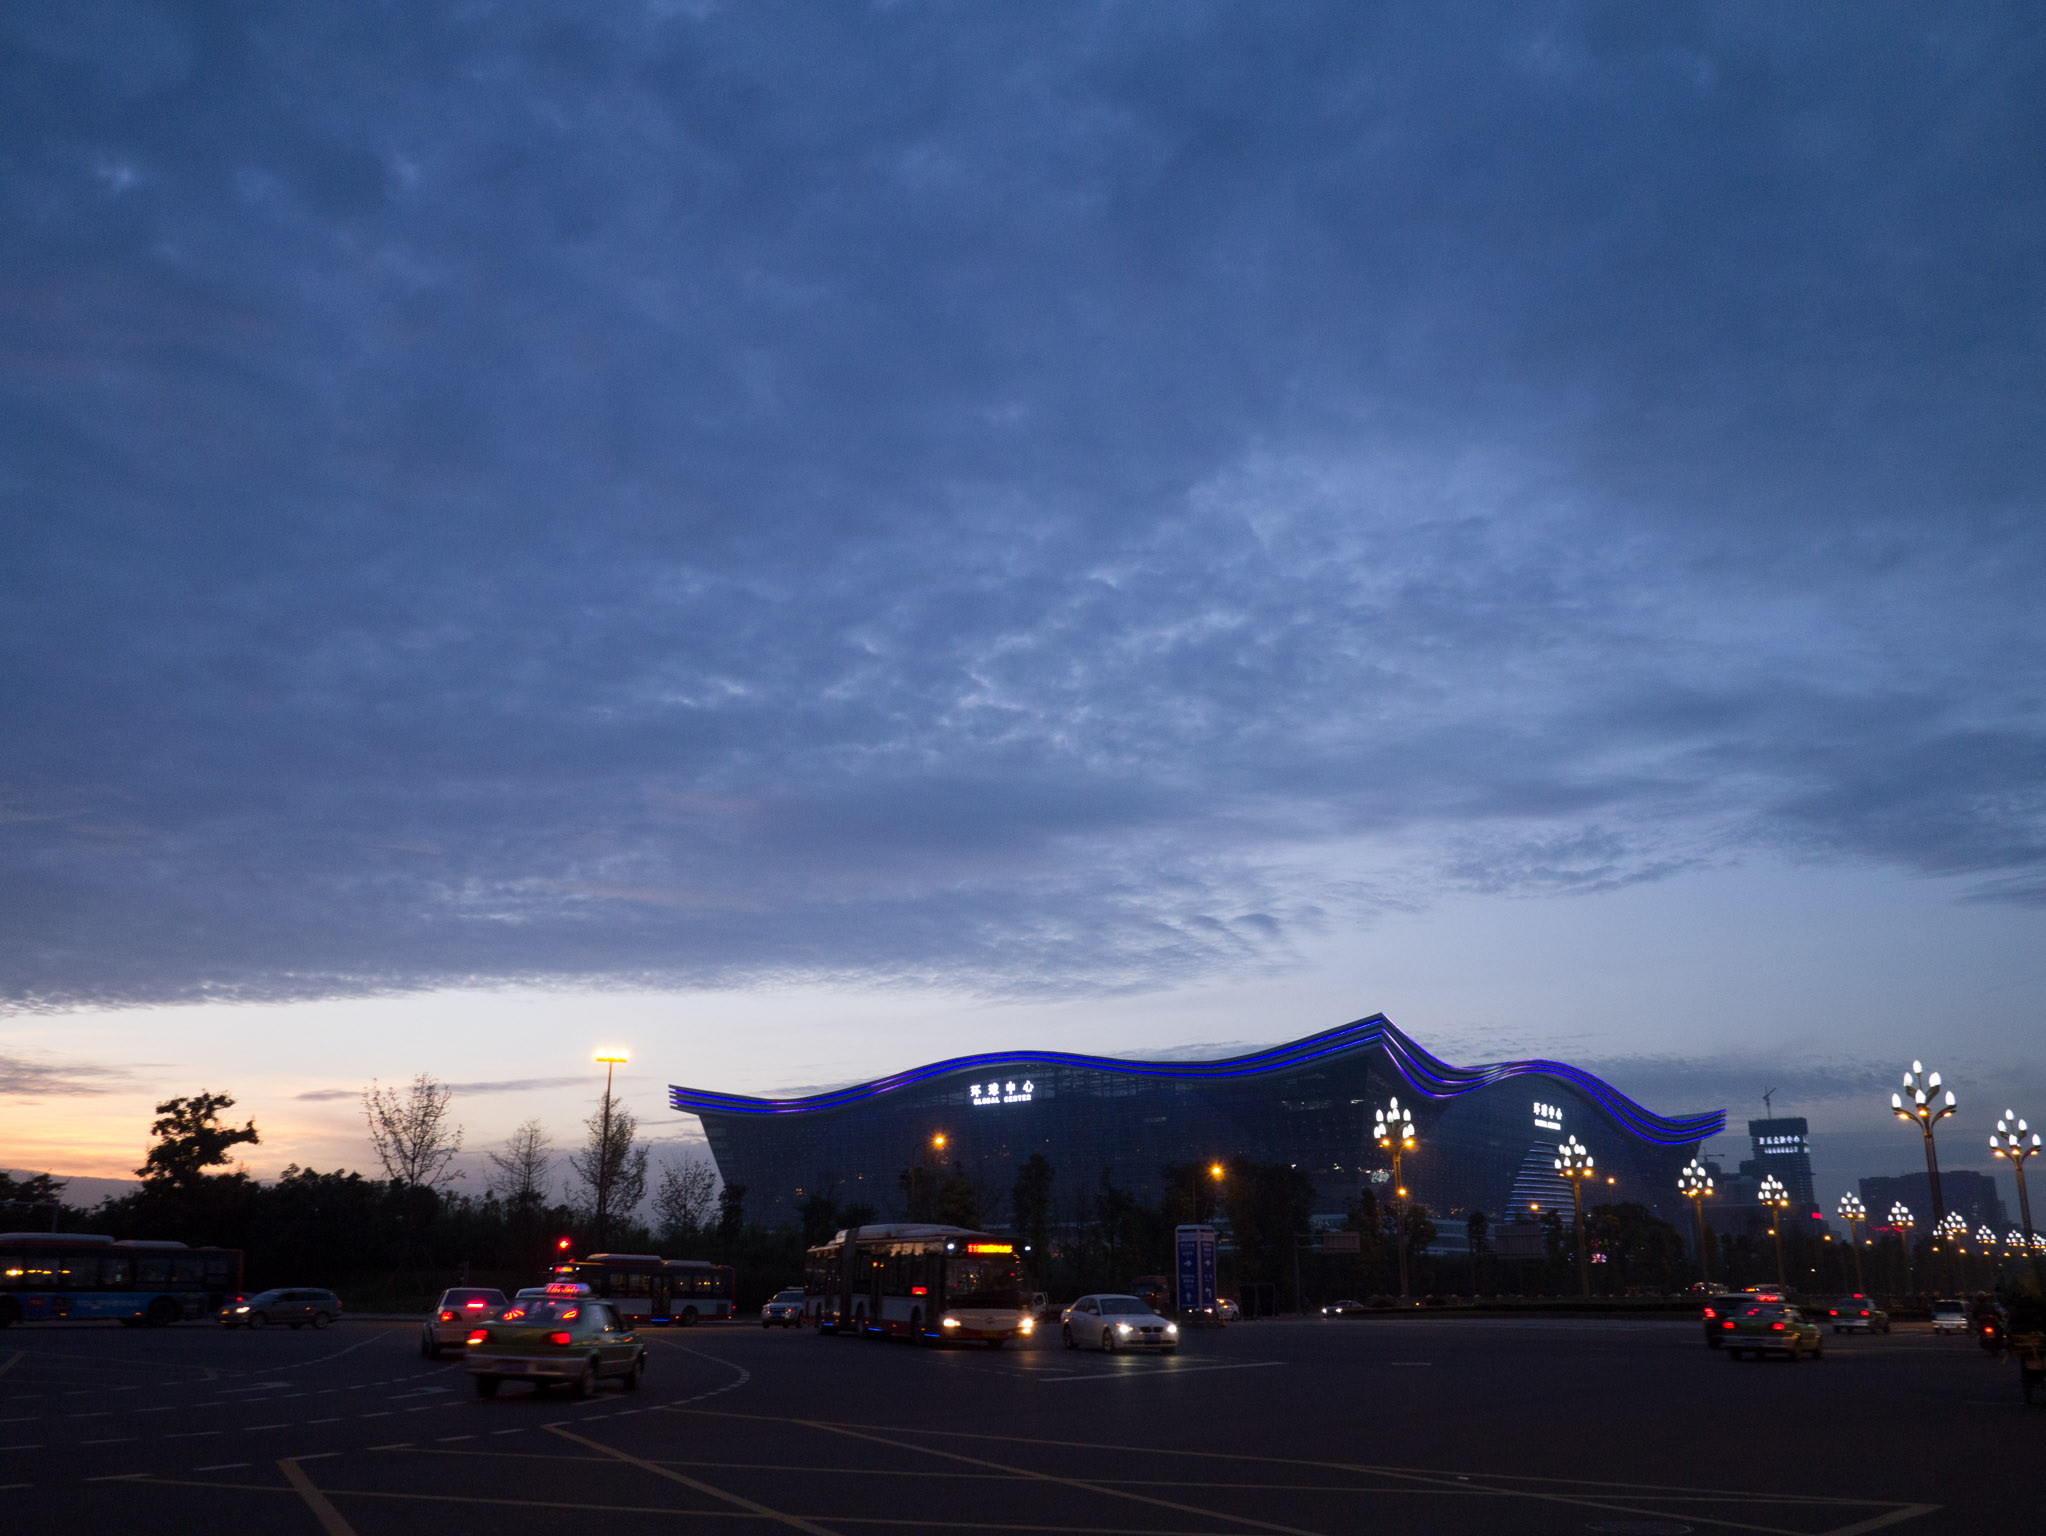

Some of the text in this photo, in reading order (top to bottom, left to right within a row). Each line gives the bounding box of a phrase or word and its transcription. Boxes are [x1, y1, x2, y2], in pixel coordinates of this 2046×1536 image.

[970, 1080, 1034, 1097] 环球中心
[973, 1094, 1032, 1105] GLOBAL CENTER
